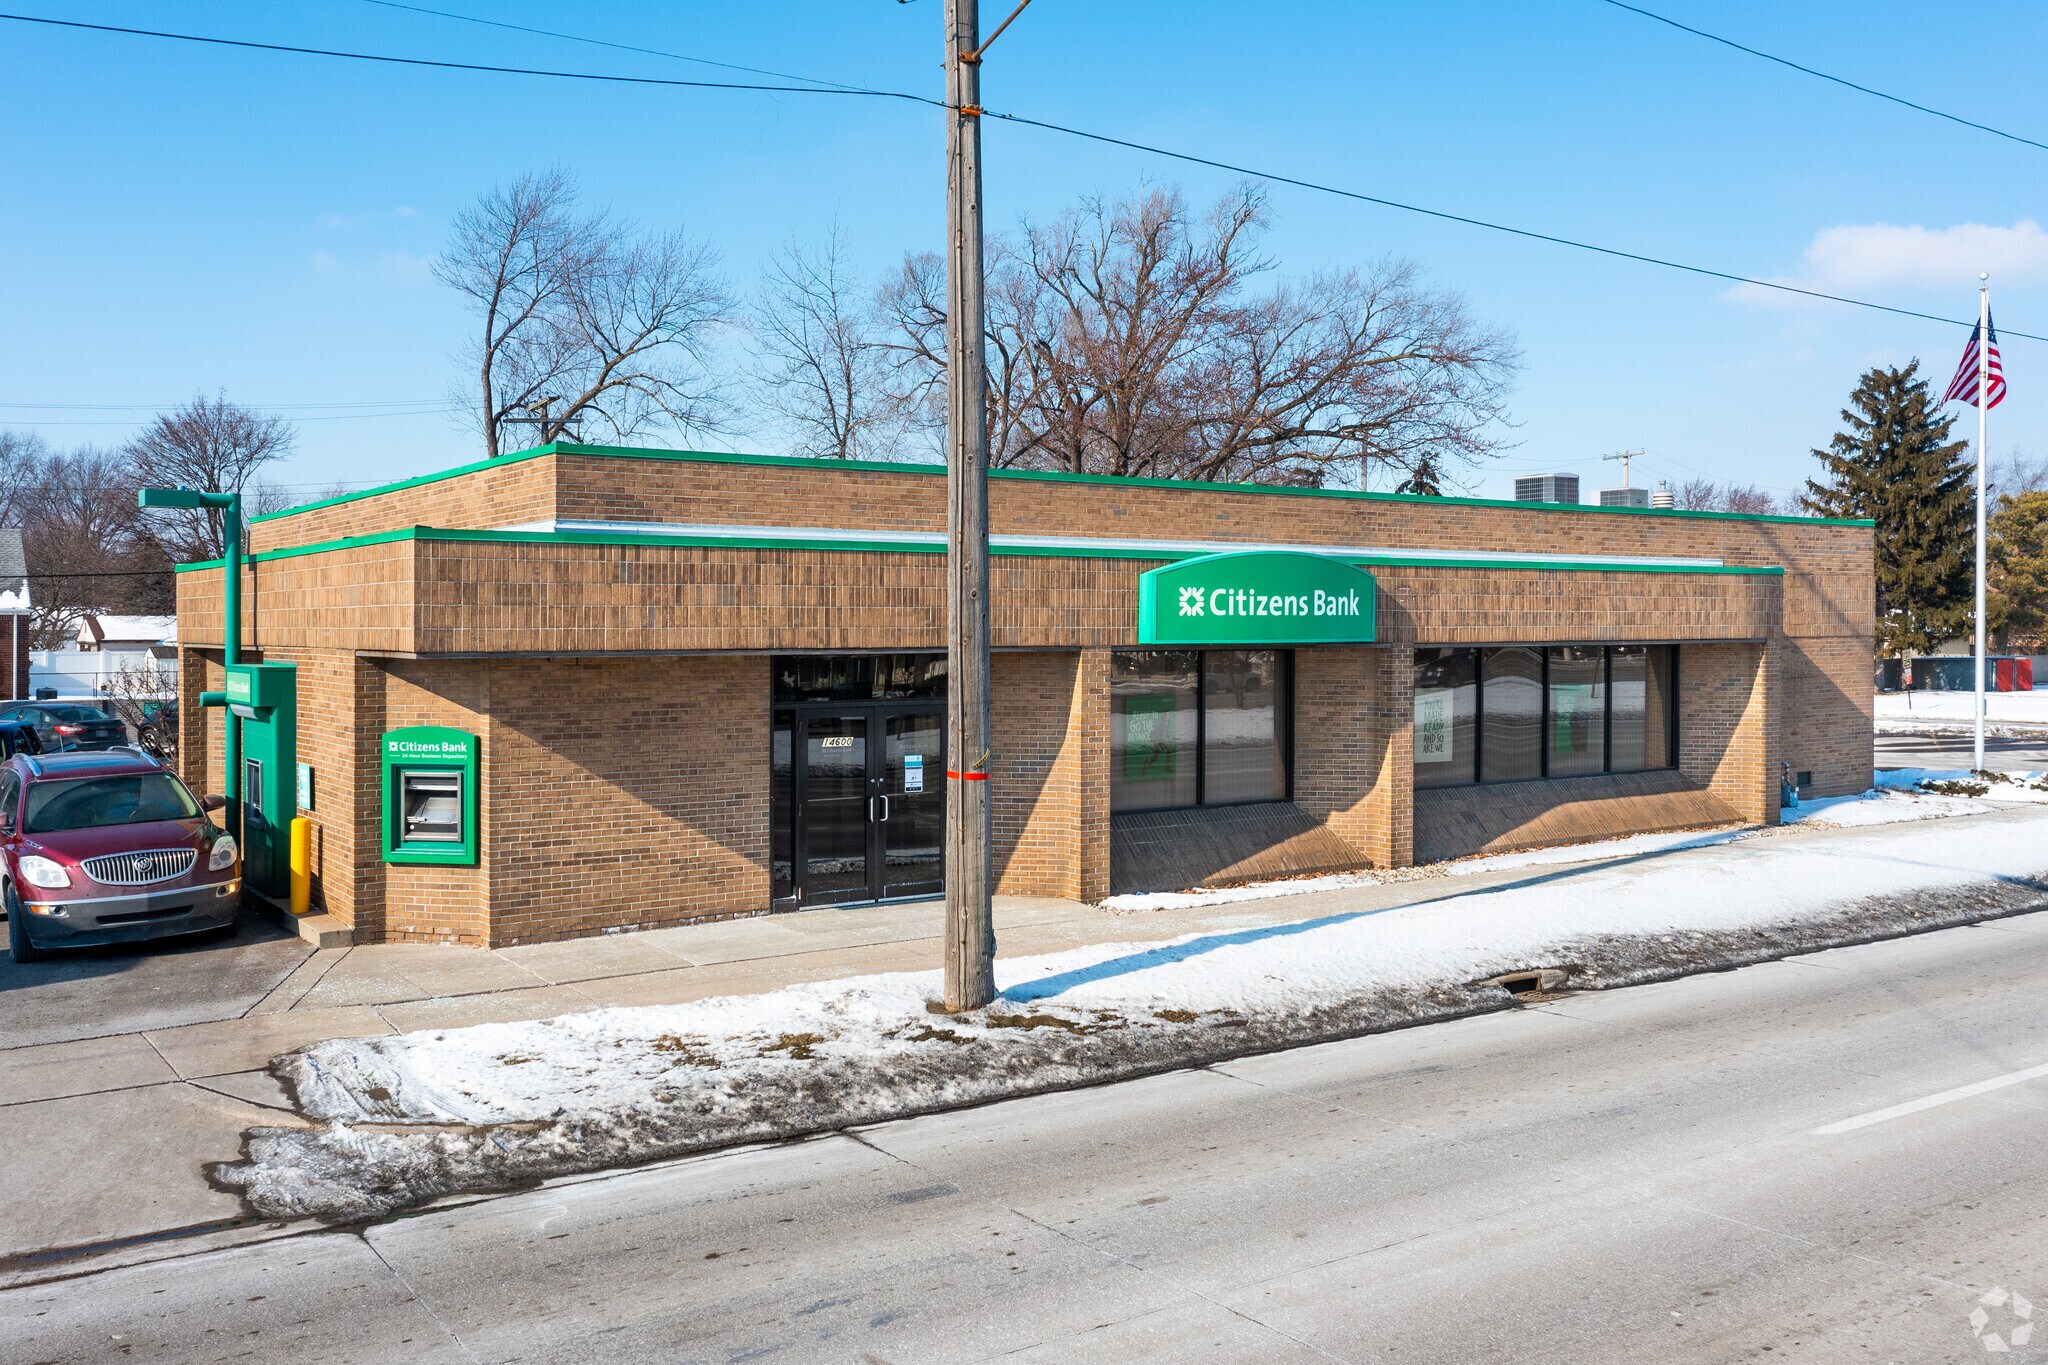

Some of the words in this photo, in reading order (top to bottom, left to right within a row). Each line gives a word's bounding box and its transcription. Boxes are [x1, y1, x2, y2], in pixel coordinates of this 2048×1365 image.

[1210, 588, 1309, 616] Citizens
[1313, 588, 1360, 616] Bank
[1424, 711, 1444, 722] MADE
[1130, 720, 1141, 732] GO
[1142, 719, 1154, 731] THE
[1423, 722, 1444, 734] READY
[824, 738, 852, 747] 14600
[1423, 733, 1436, 744] AND
[1436, 733, 1444, 744] SO
[399, 741, 440, 752] Citizens
[441, 741, 467, 752] Bank
[1423, 744, 1435, 754] ARE
[1435, 743, 1444, 753] WE
